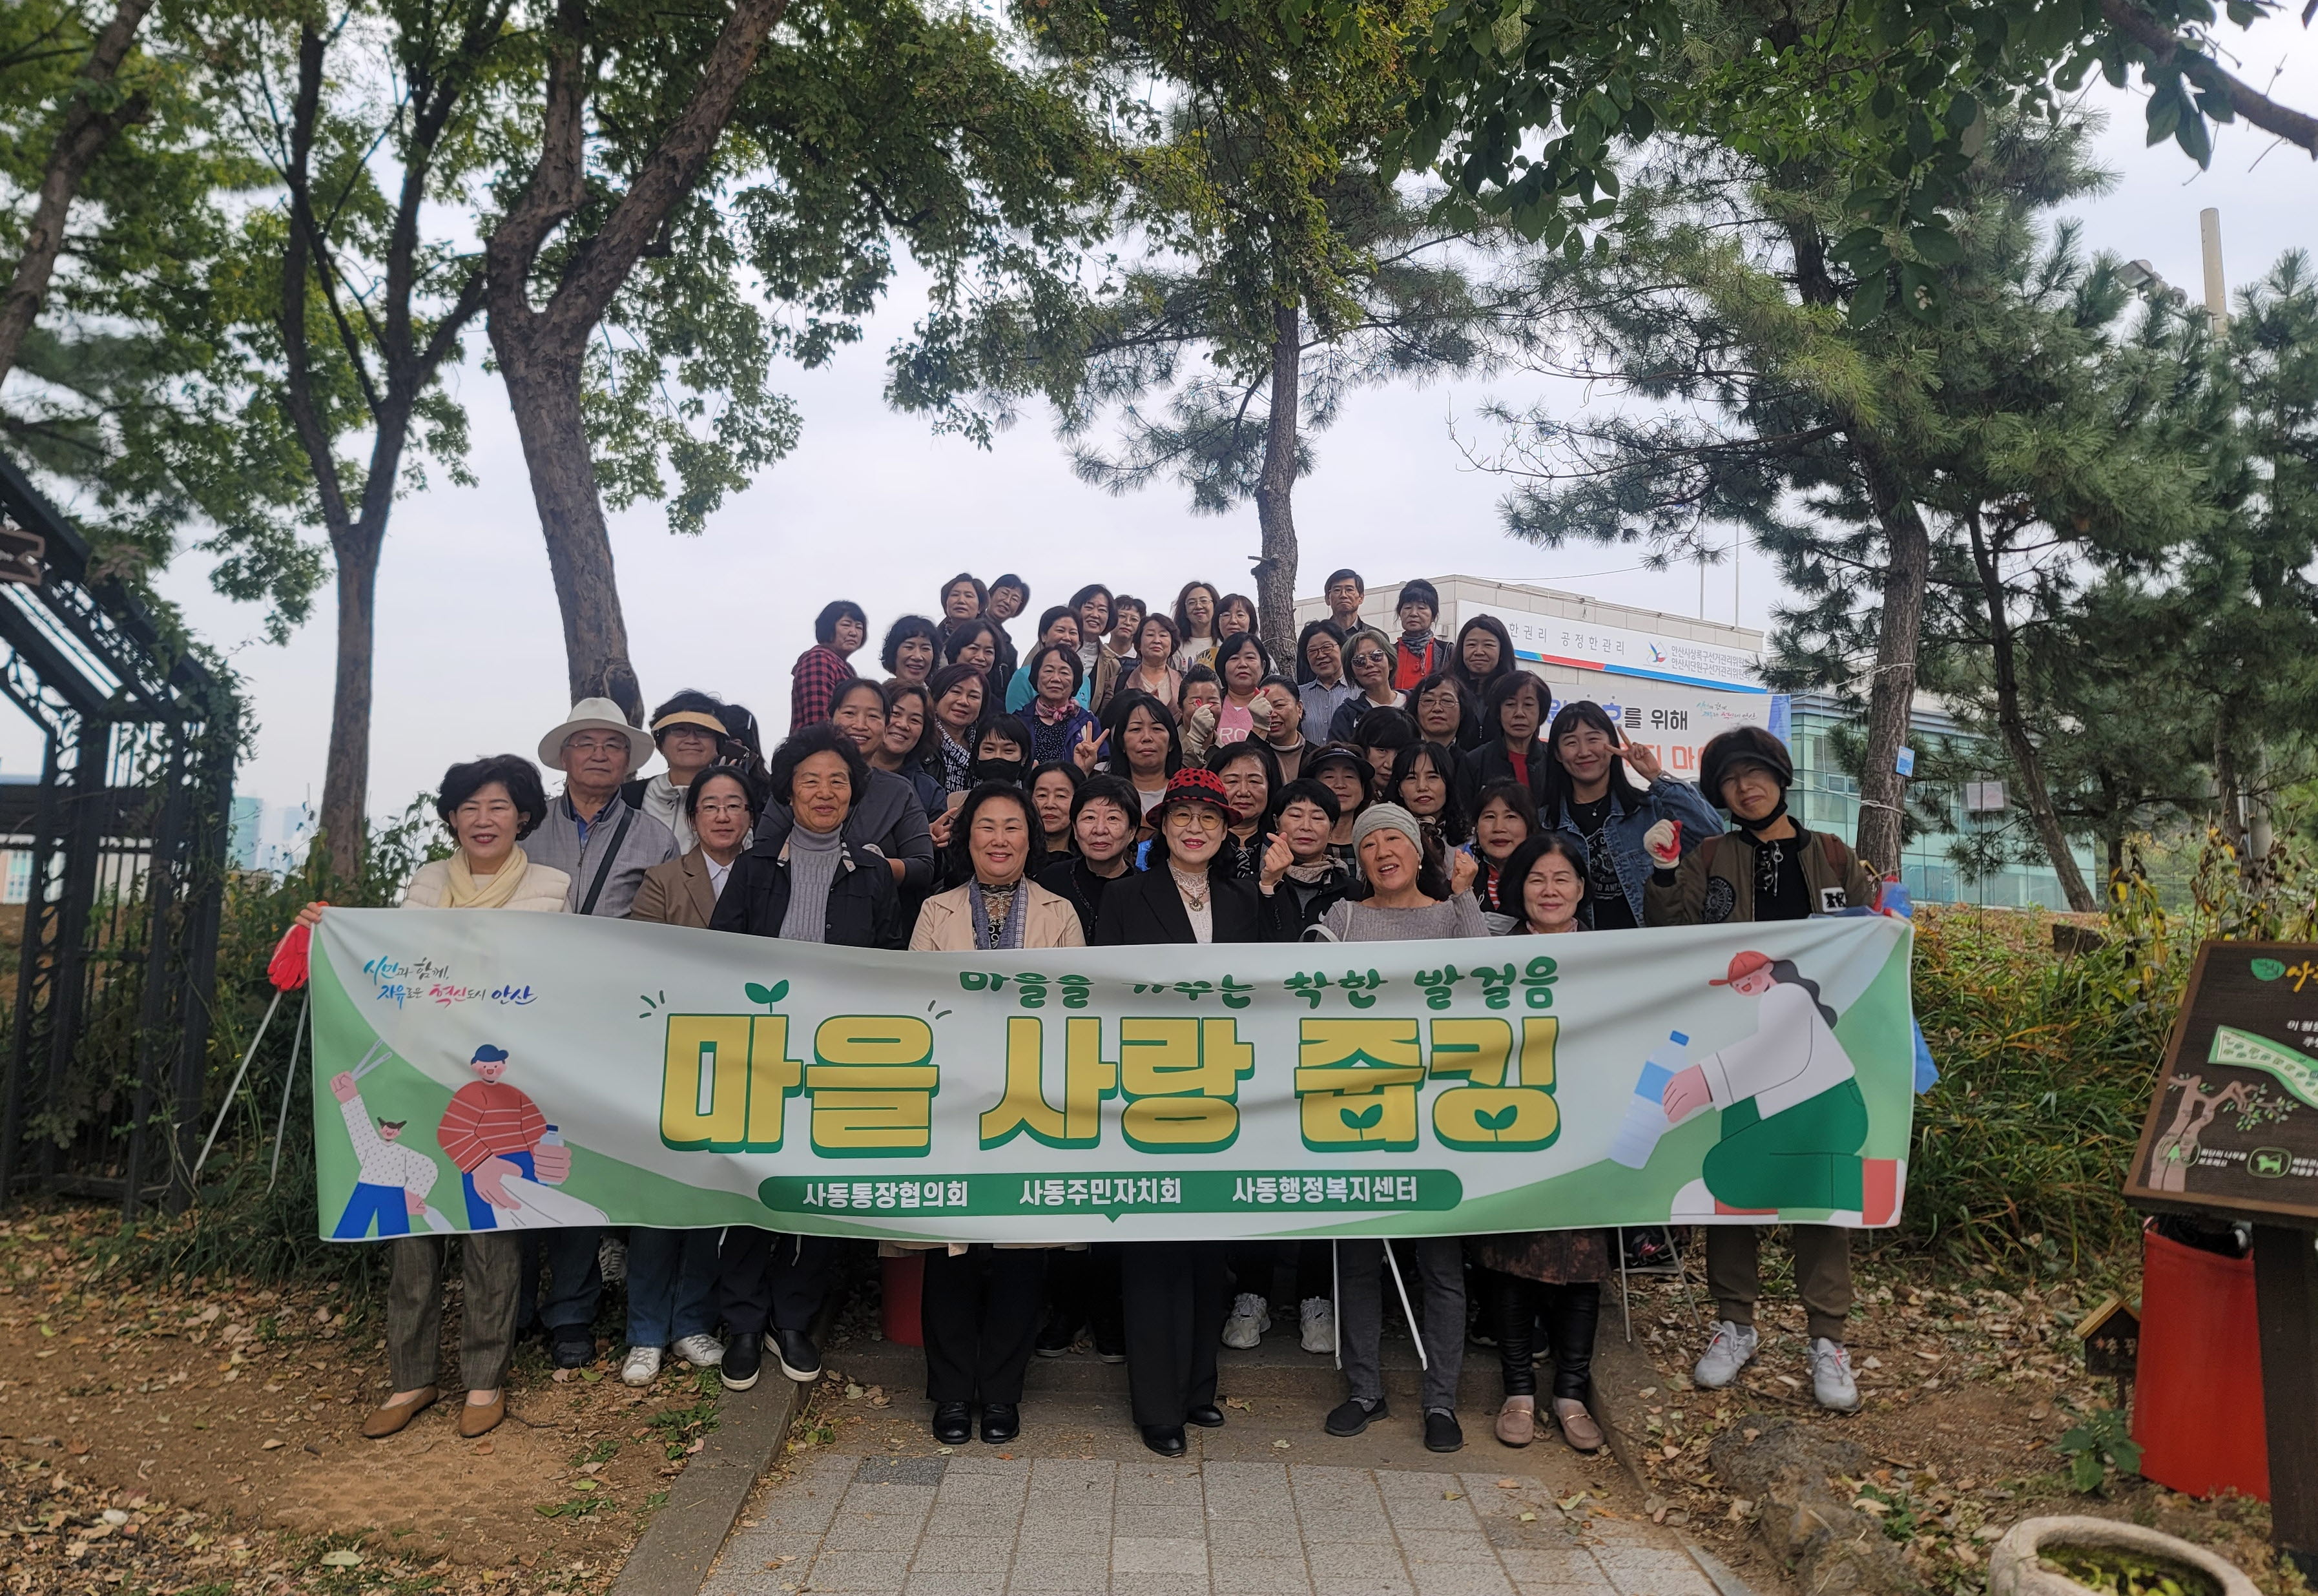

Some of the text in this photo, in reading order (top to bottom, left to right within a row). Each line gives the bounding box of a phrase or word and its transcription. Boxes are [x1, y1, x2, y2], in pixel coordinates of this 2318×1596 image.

[1509, 623, 1625, 655] 한권리 공정한관리
[1602, 702, 1689, 731] 호를 위해
[1671, 745, 1705, 771] 마
[363, 955, 413, 986] 시민과
[959, 971, 1095, 1009] 마을을
[1283, 968, 1389, 1010] 착한
[1413, 956, 1559, 1010] 발걸음
[377, 984, 539, 1010] 자유로운 혁신도시 안산
[659, 1013, 1562, 1159] 마을 사랑 줍킹
[802, 1175, 1418, 1209] 사동통장협의회 사동주민자치회 사동행정복지센터
